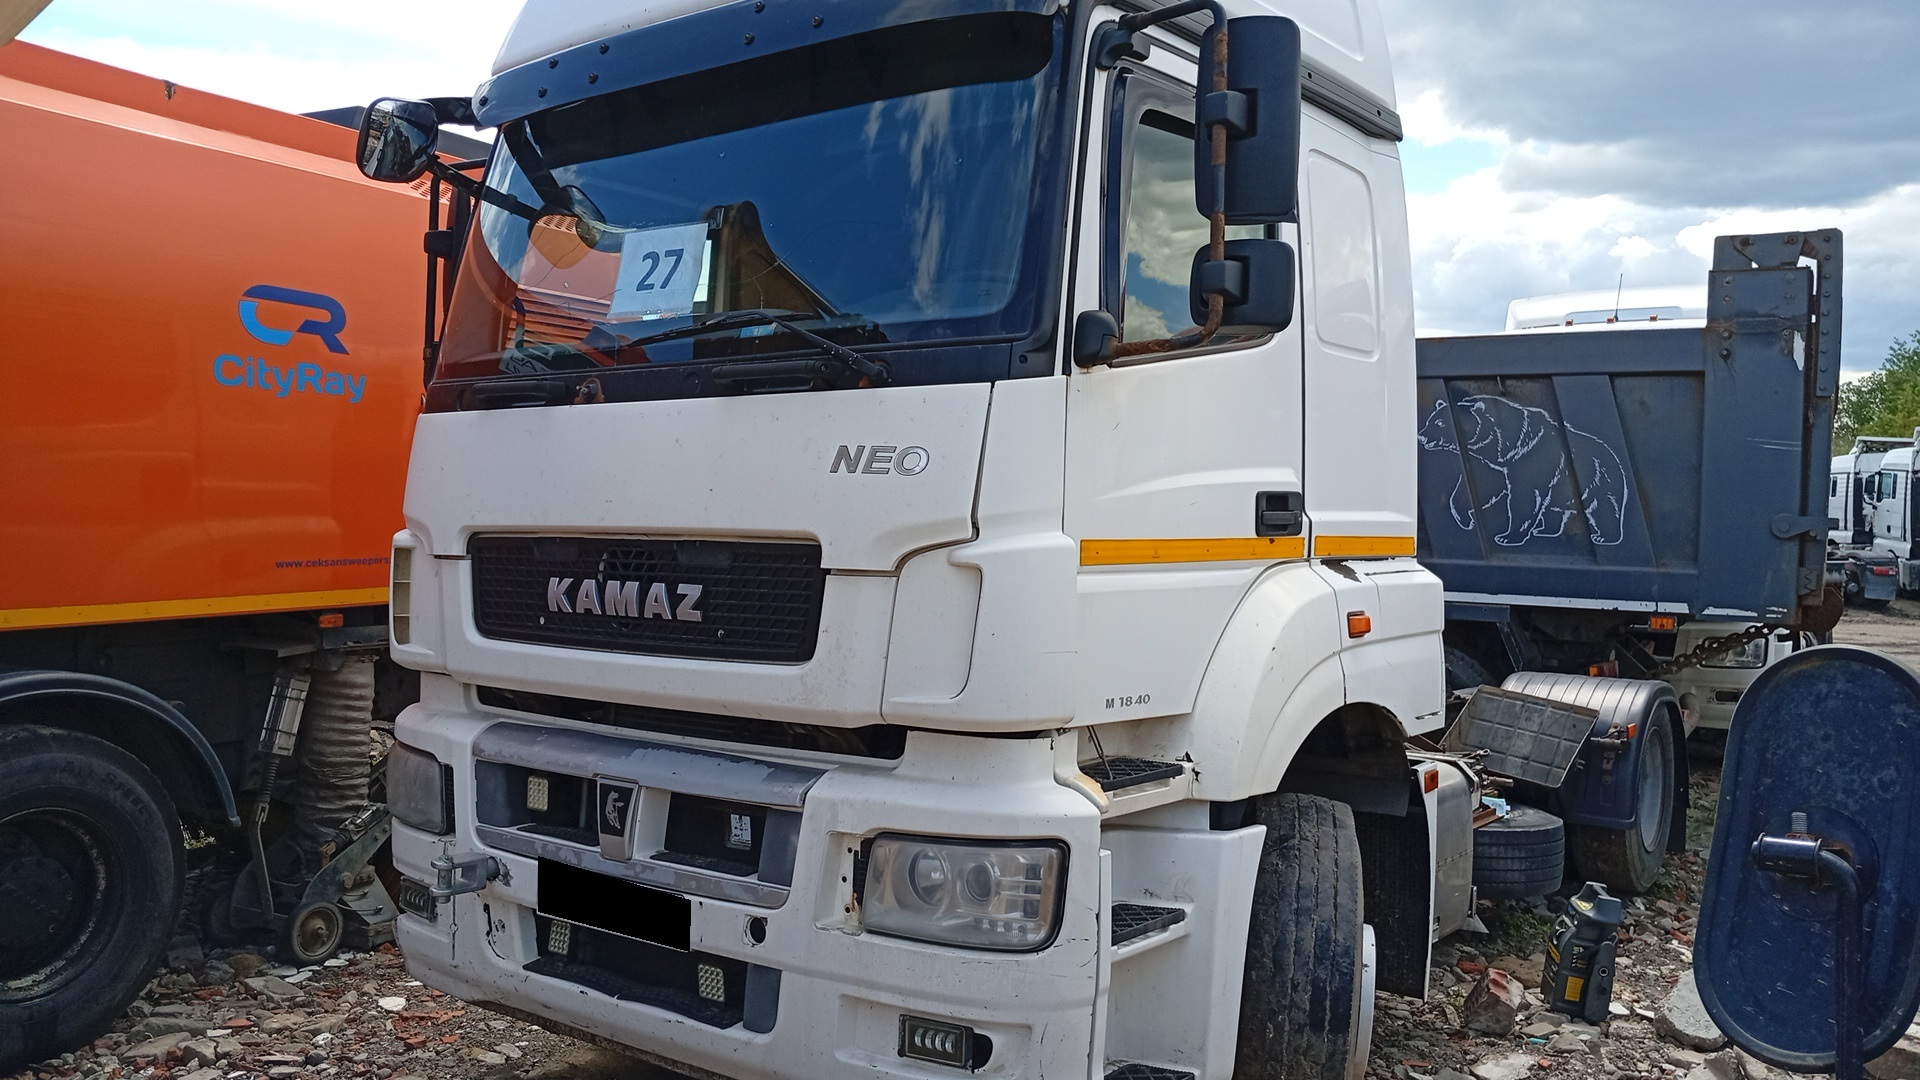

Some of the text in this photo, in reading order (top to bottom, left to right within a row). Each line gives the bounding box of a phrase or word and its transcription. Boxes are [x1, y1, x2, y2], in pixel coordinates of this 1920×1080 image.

[635, 248, 684, 292] 27
[213, 353, 367, 403] CityRay
[829, 445, 930, 476] NEO
[547, 577, 703, 622] KAMAZ
[1105, 693, 1151, 709] M 1840
